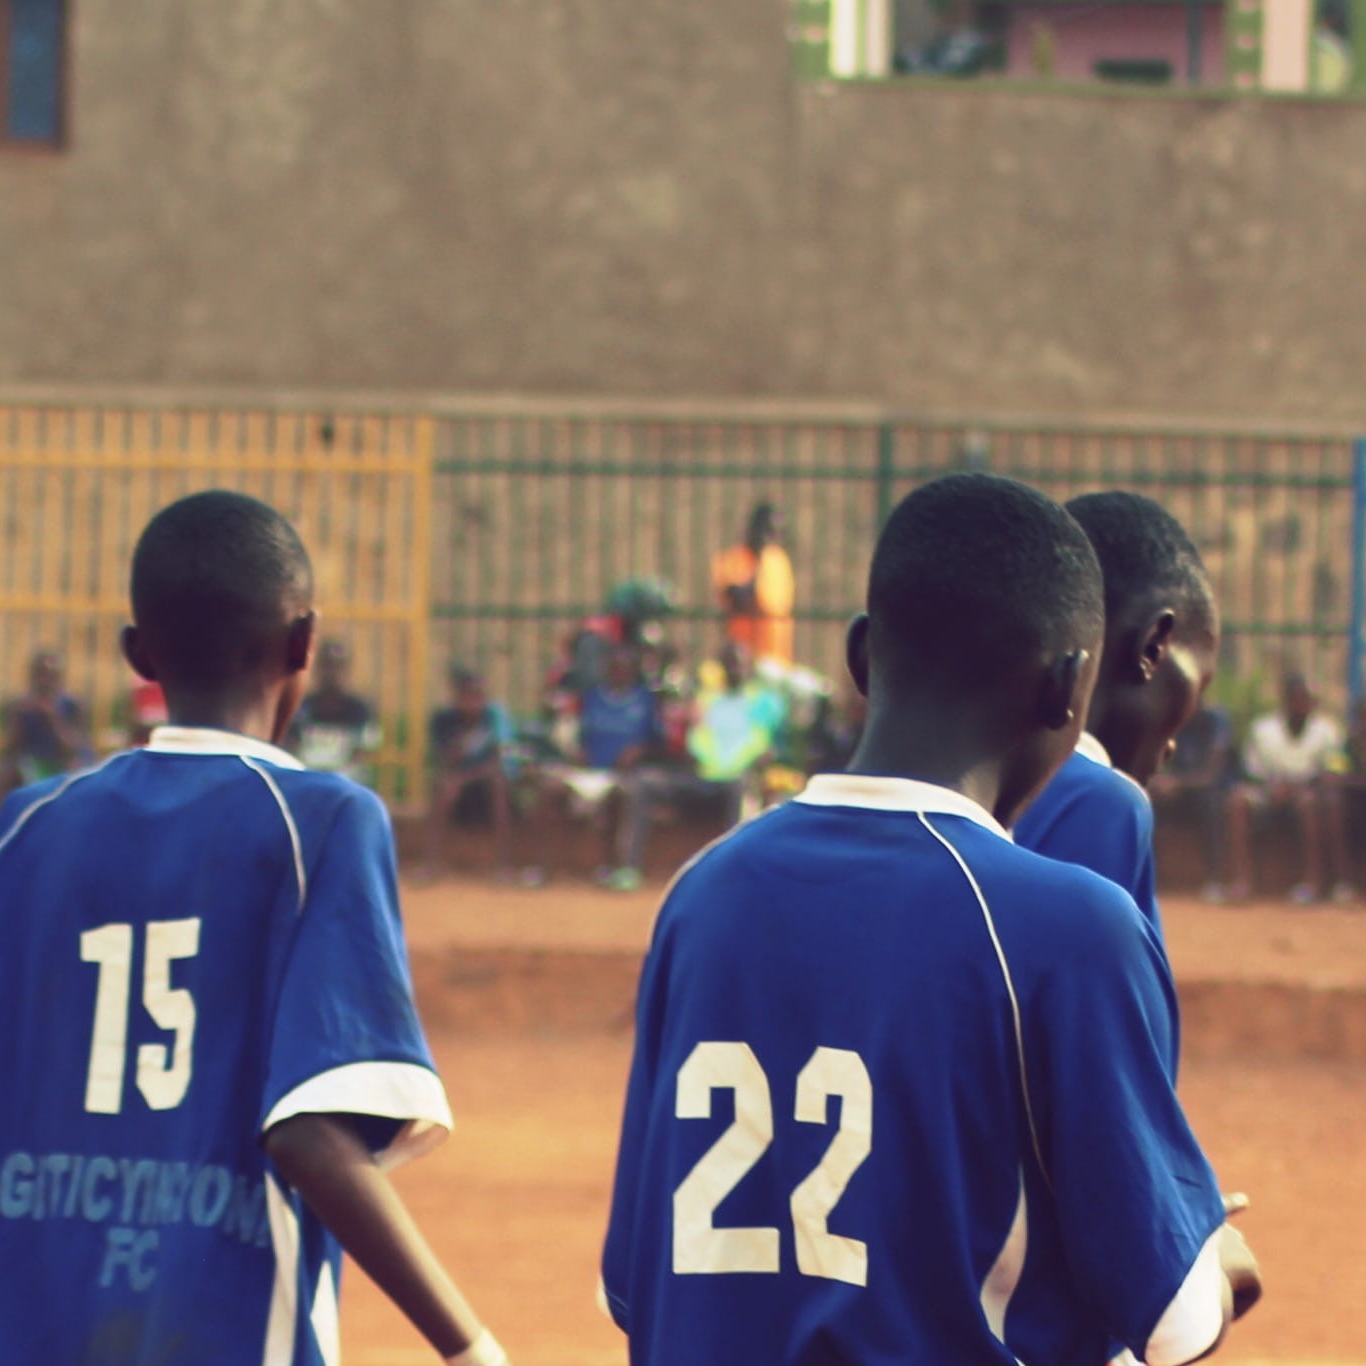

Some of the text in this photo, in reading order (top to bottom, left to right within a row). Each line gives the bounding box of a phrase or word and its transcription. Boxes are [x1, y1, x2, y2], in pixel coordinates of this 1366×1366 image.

[80, 917, 201, 1114] 15
[98, 1226, 160, 1292] FC
[672, 1040, 873, 1287] 22
